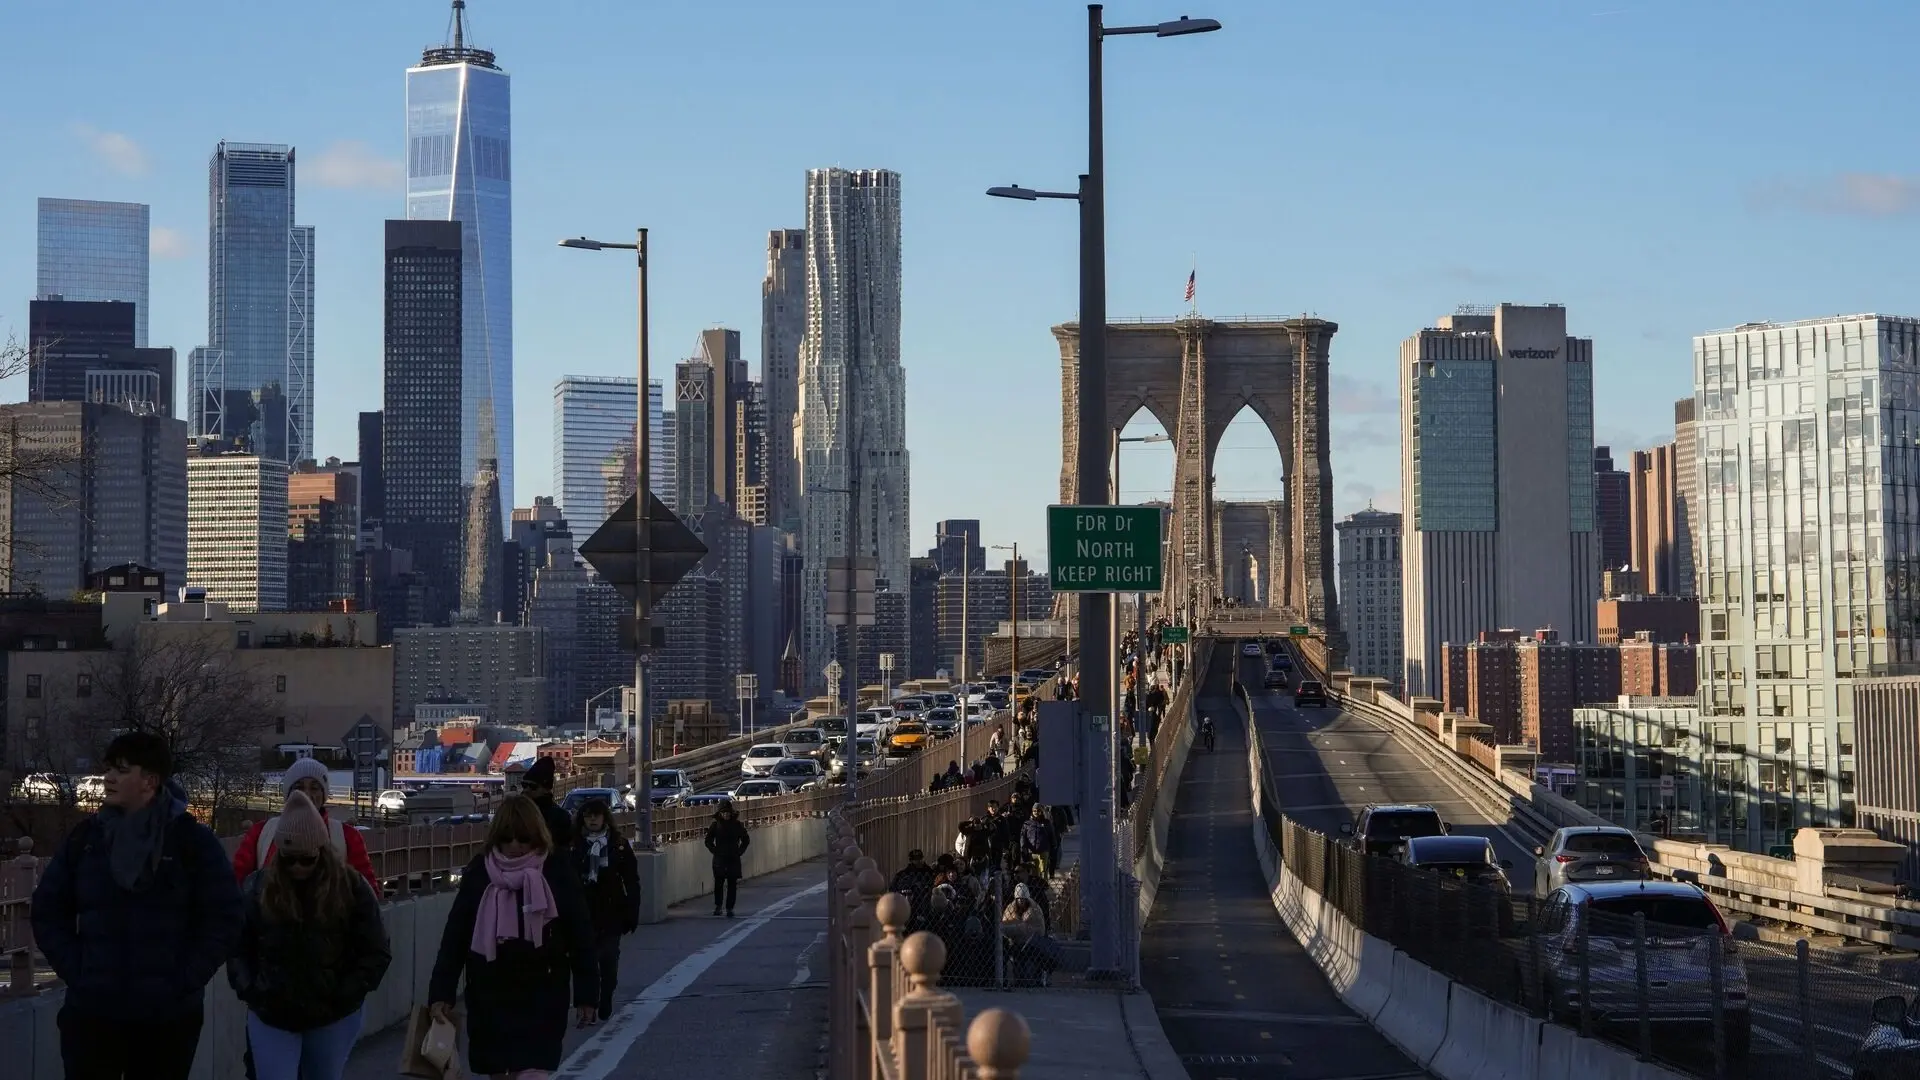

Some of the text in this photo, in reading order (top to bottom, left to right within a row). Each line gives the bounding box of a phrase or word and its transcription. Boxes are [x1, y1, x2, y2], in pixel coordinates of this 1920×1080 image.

[1508, 347, 1555, 359] verizon
[1076, 515, 1133, 531] FDR Dr
[1076, 539, 1134, 558] NORTH
[1058, 566, 1153, 582] KEEP RIGHT
